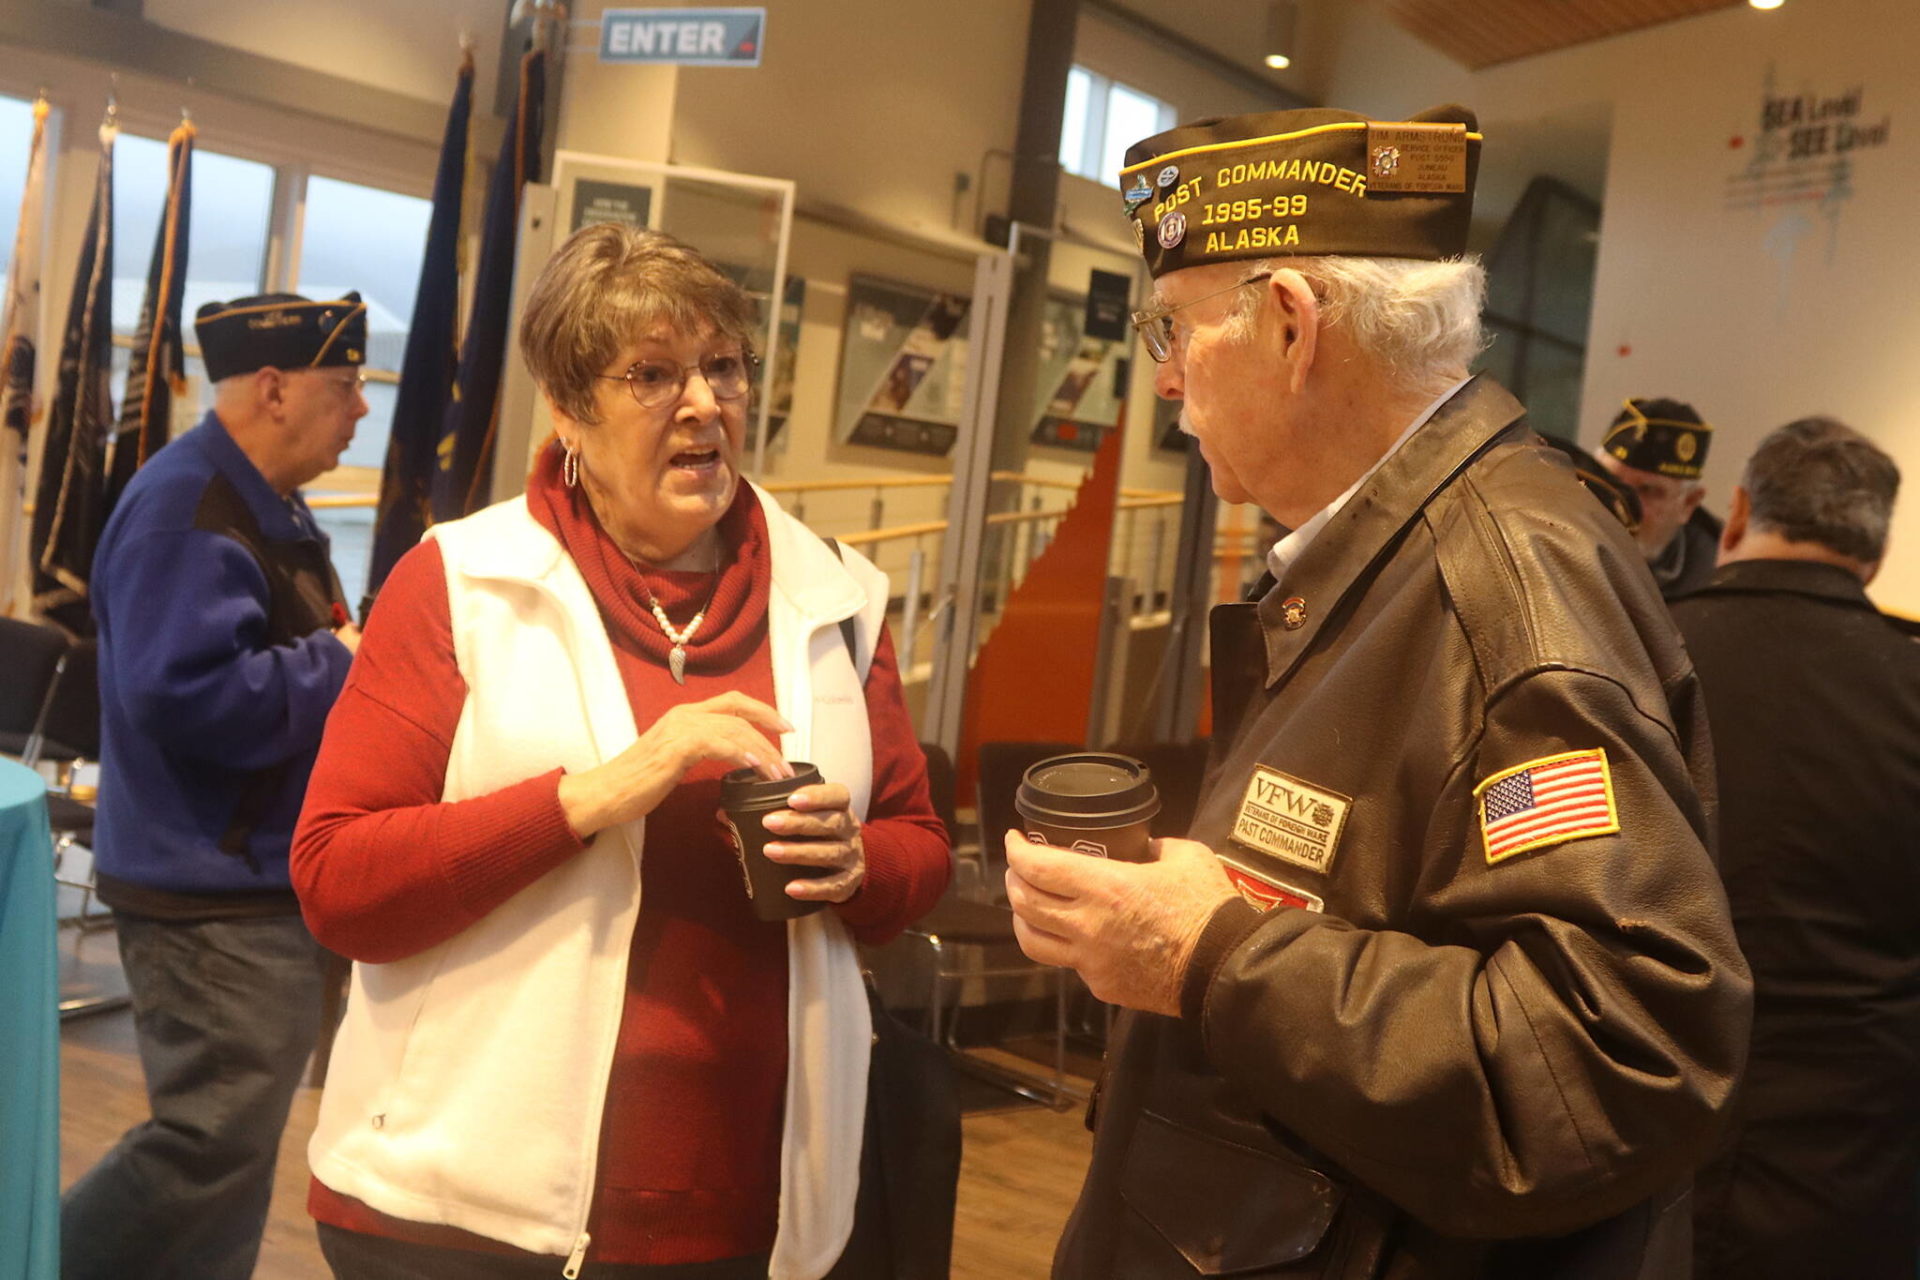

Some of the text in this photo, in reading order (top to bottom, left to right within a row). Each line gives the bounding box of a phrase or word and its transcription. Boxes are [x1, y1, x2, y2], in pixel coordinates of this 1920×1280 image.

[609, 21, 726, 54] ENTER
[1395, 131, 1465, 143] ARMSTRONG
[1154, 160, 1367, 223] POST COMMANDER
[1202, 195, 1308, 225] 1995-99
[1206, 224, 1300, 253] ALASKA
[1255, 777, 1318, 817] VFW
[1237, 818, 1325, 864] PAST COMMANDER
[1245, 804, 1328, 843] VETERANS OF FOREIGN WARS
